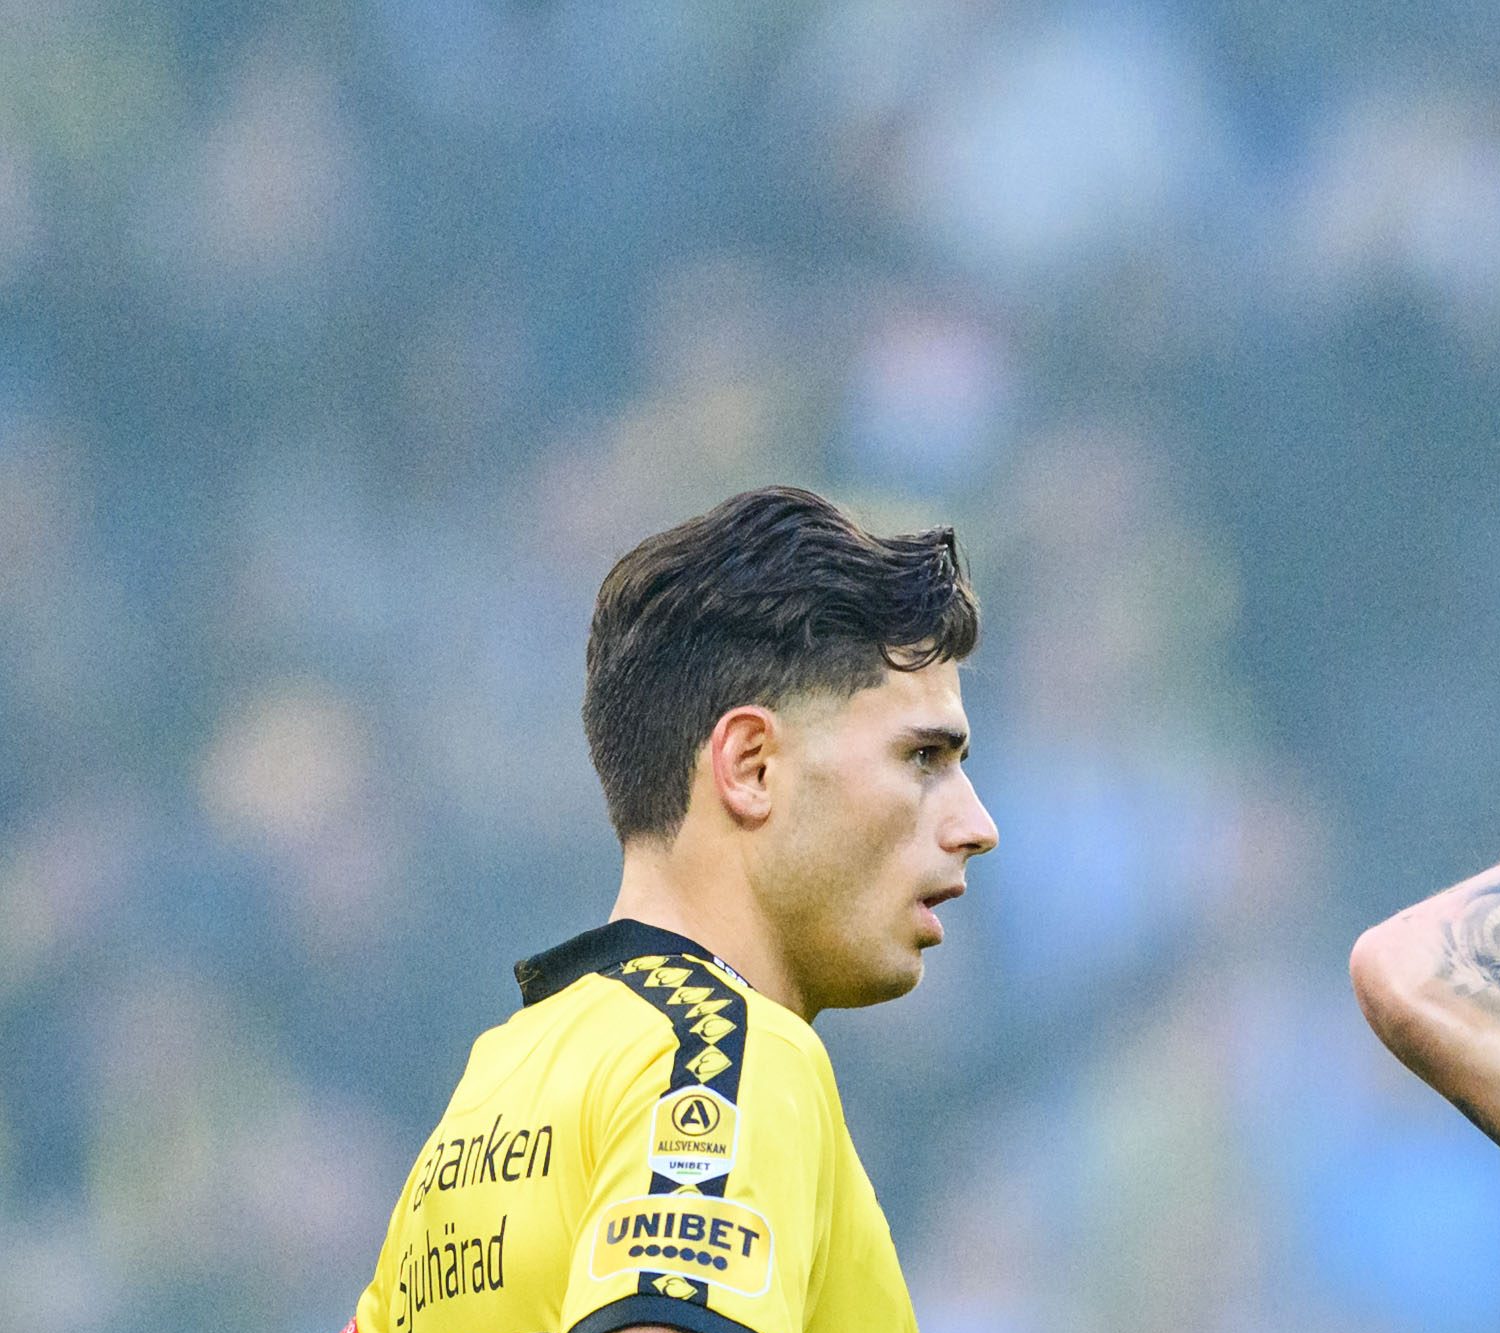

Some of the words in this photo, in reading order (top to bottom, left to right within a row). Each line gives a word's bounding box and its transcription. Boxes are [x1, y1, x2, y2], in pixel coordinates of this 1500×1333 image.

[657, 1139, 727, 1155] ALLSVENSKAN
[668, 1160, 712, 1172] UNIBET
[606, 1212, 760, 1259] UNIBET
